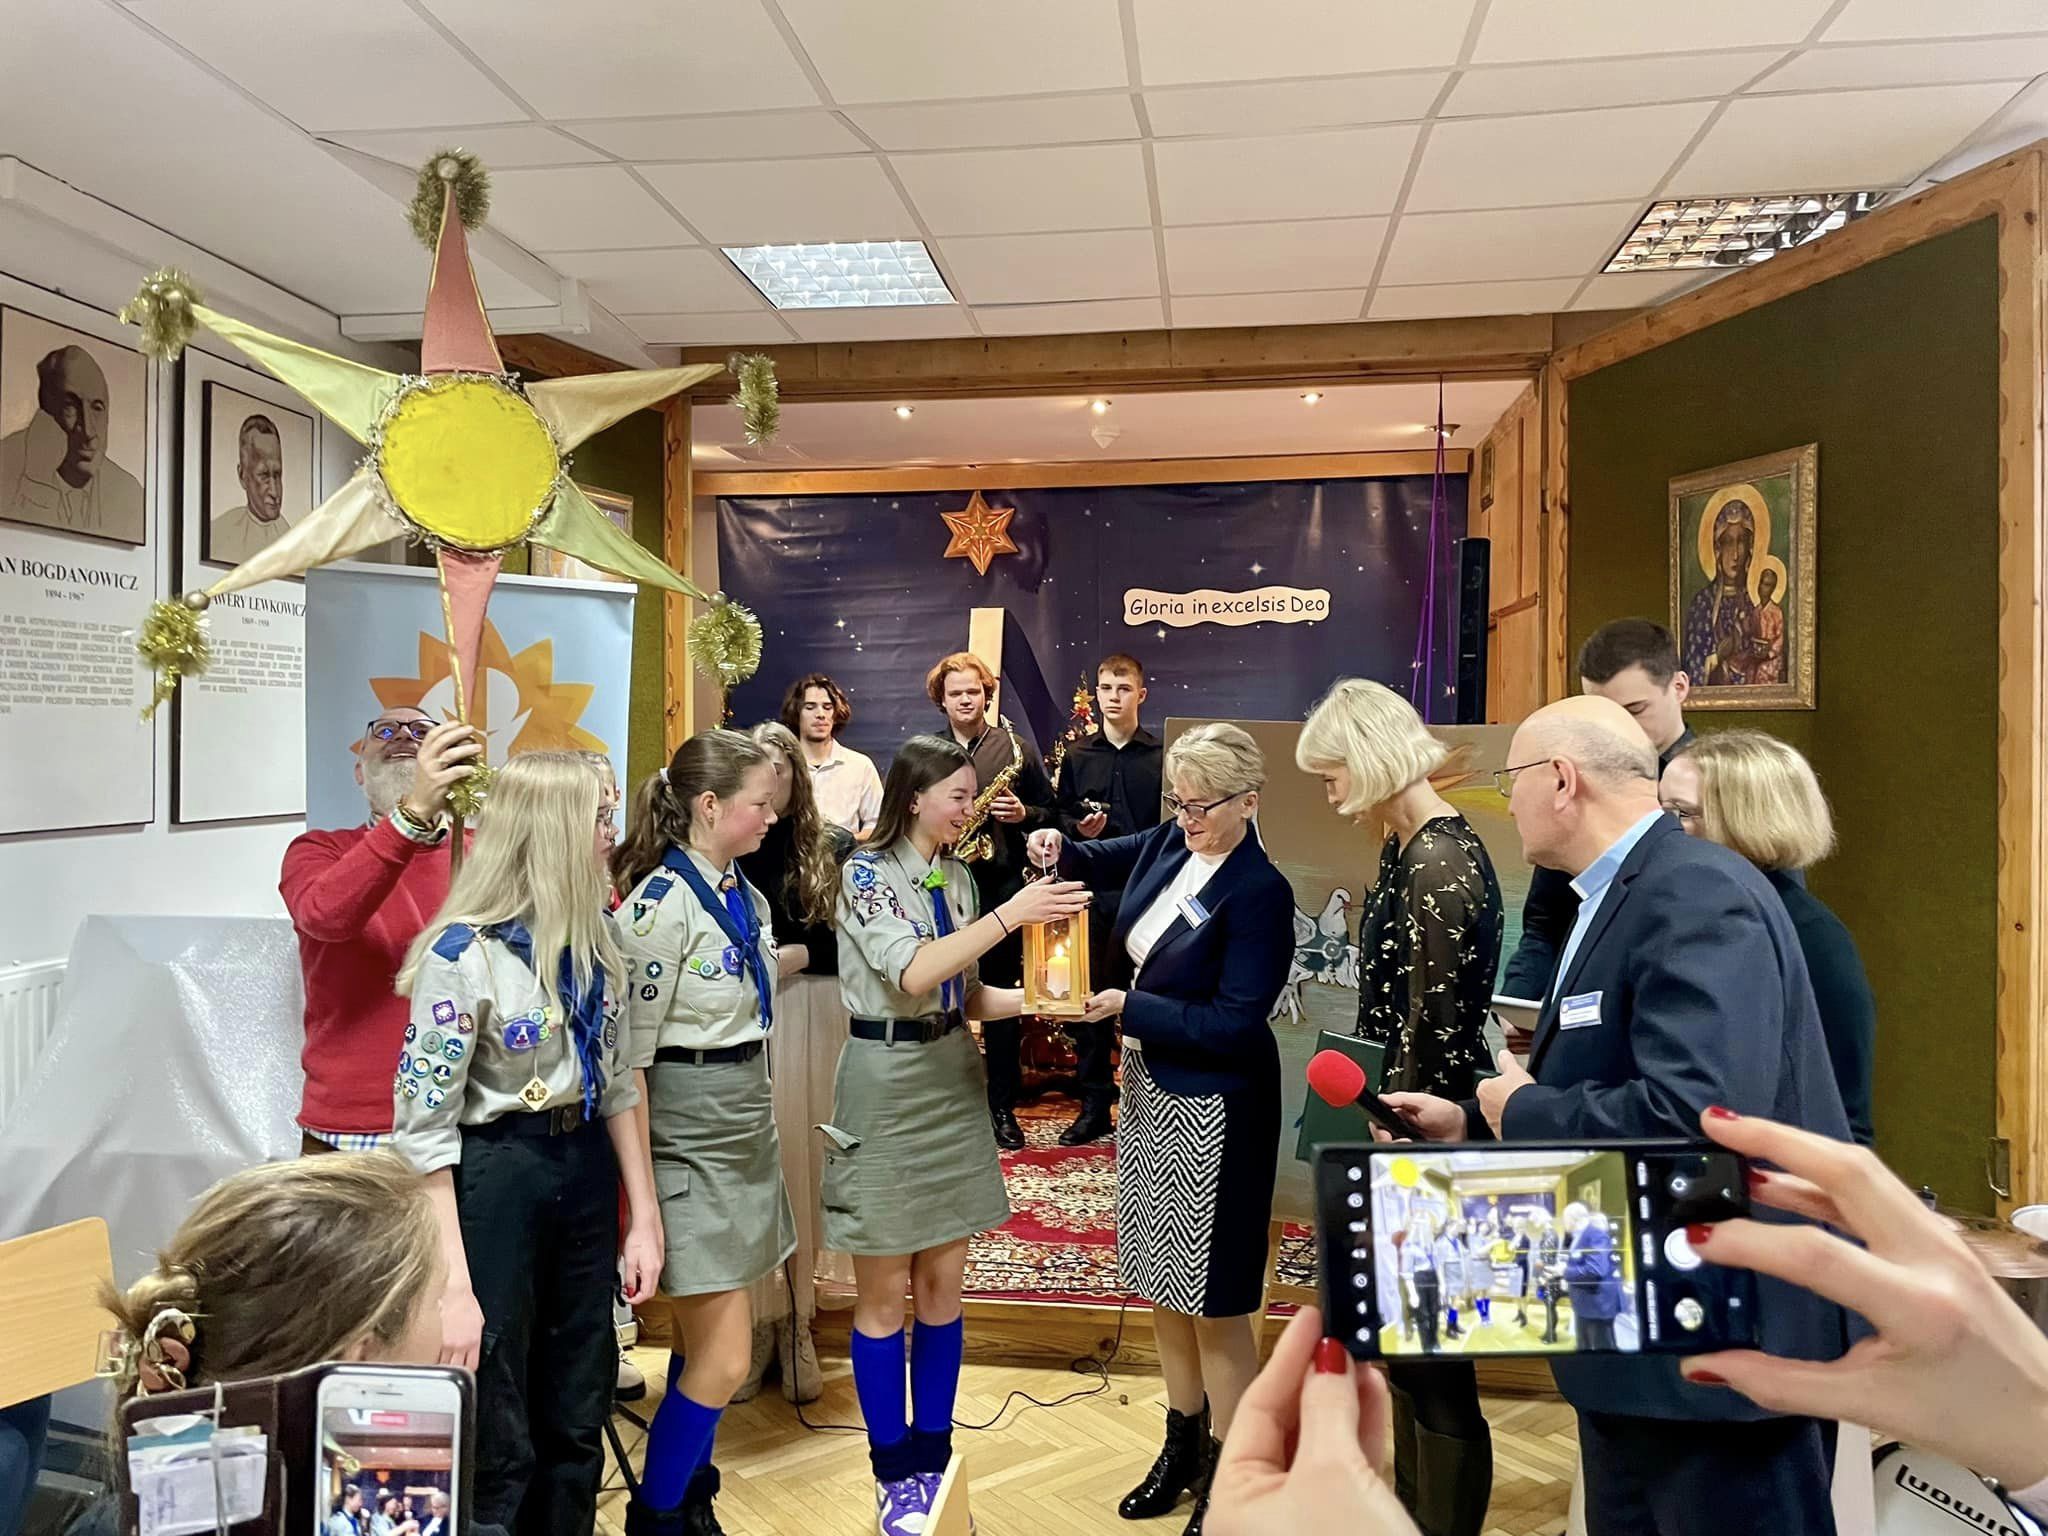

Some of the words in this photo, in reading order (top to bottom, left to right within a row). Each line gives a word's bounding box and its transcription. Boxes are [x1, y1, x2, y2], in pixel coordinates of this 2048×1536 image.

[22, 559, 139, 590] BOGDANOWICZ
[249, 596, 306, 617] LEWKOWICZ
[1130, 598, 1185, 615] Gloria
[1193, 599, 1208, 614] in
[1211, 596, 1286, 614] excelsis
[1291, 596, 1325, 612] Deo
